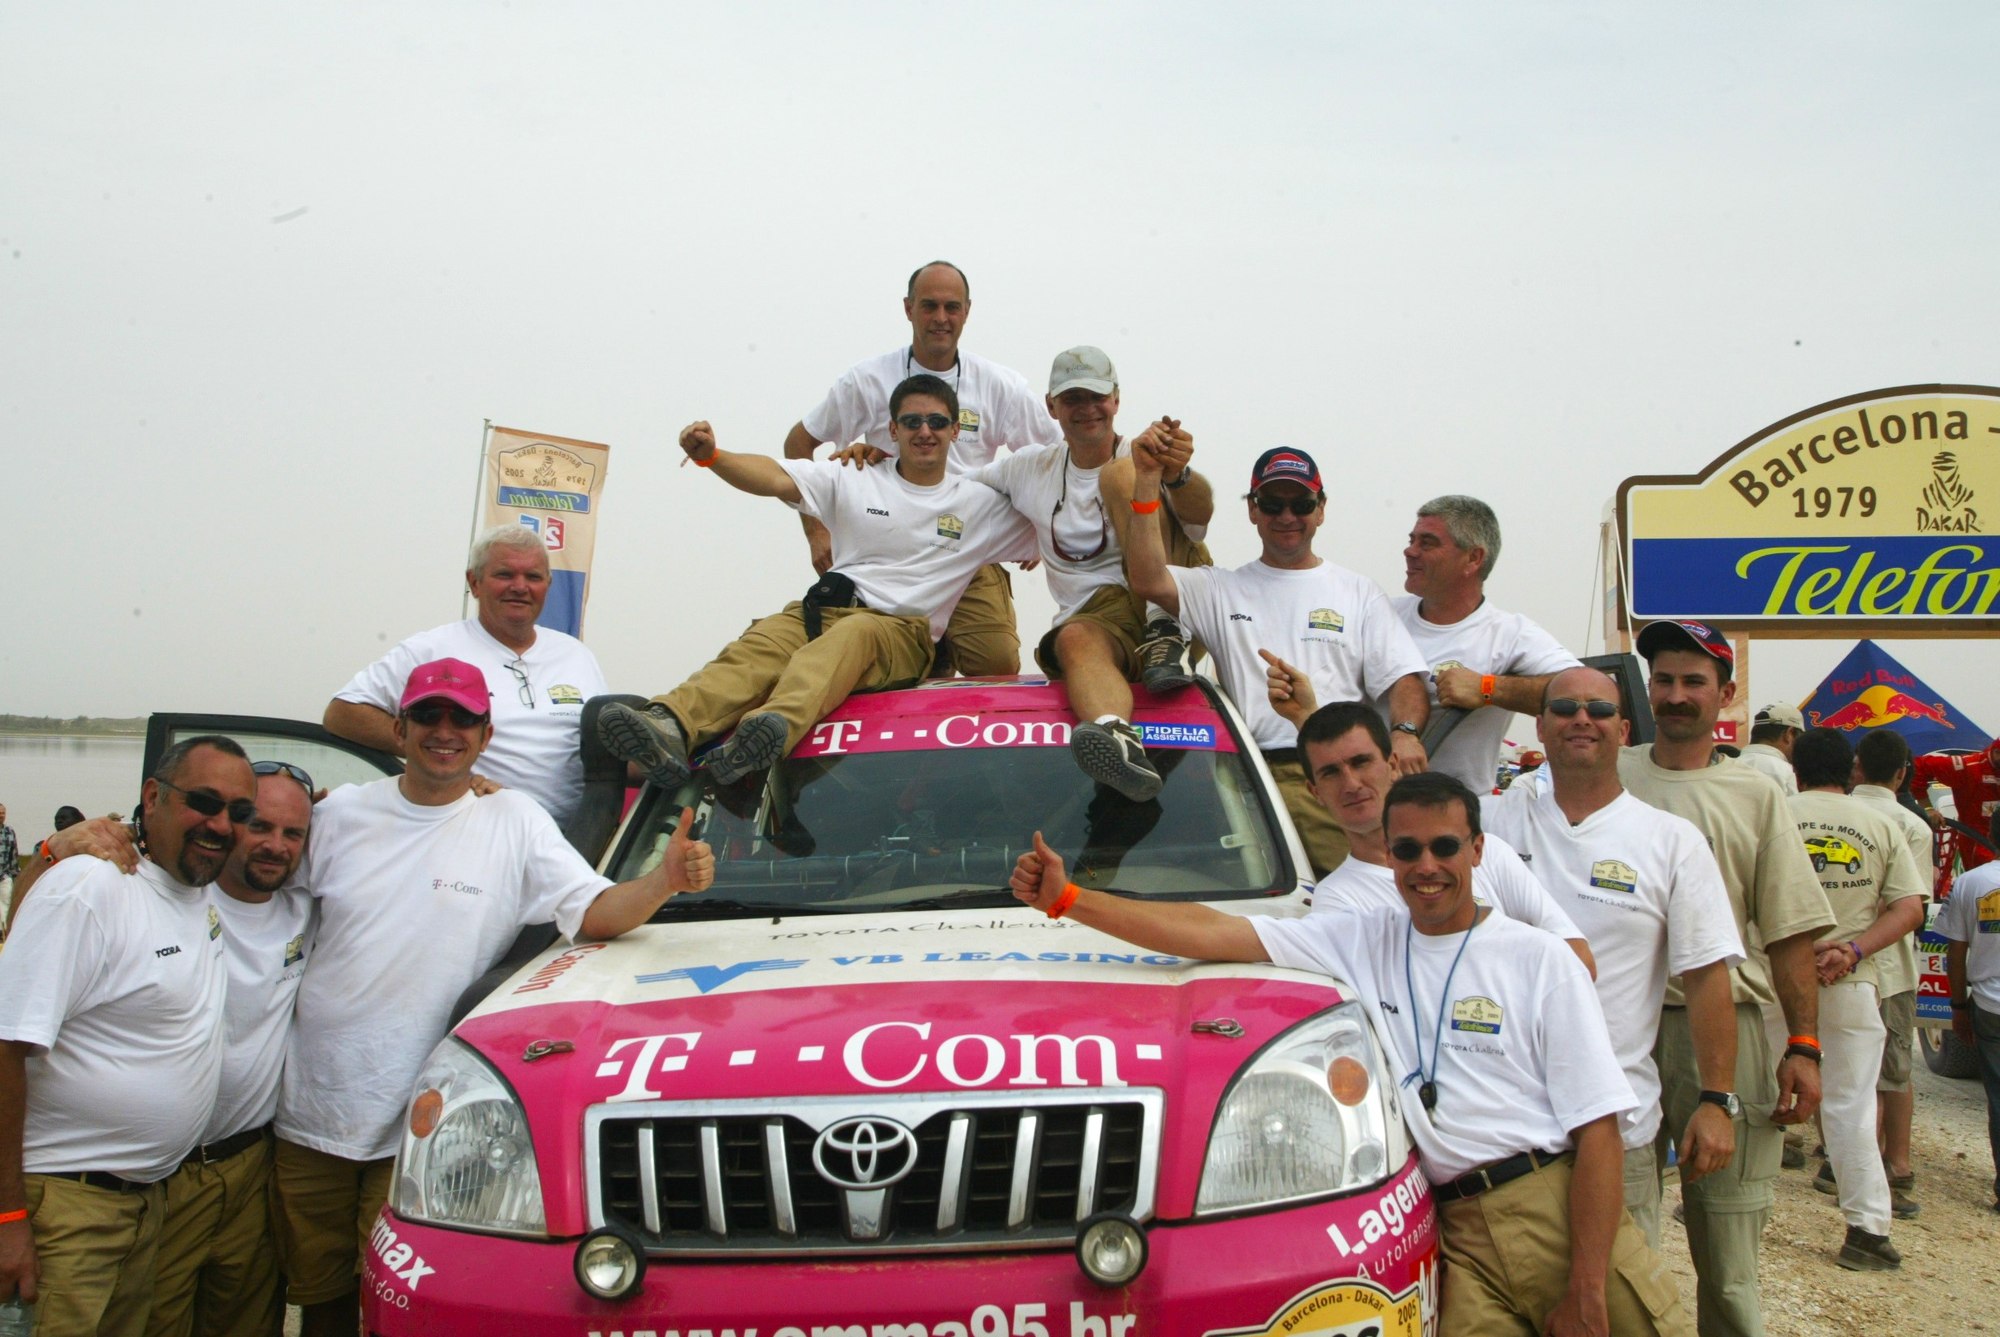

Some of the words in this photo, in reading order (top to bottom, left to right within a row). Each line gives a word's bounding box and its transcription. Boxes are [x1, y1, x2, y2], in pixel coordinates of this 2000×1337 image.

[1729, 408, 1969, 508] Barcelona
[1791, 486, 1878, 518] 1979
[1916, 507, 1982, 534] DAKAR
[1831, 670, 1873, 697] Red
[1144, 725, 1209, 736] FIDELIA
[1145, 733, 1211, 743] ASSISTANCE
[1820, 823, 1834, 831] du
[1837, 825, 1877, 853] MONDE
[1841, 878, 1873, 889] RAIDS
[768, 926, 900, 941] TOYOTA
[830, 953, 905, 967] VB
[921, 951, 1184, 967] LEASING
[1281, 1293, 1343, 1332] Barcelona
[1354, 1289, 1385, 1312] Dakar
[1397, 1299, 1417, 1327] 2005
